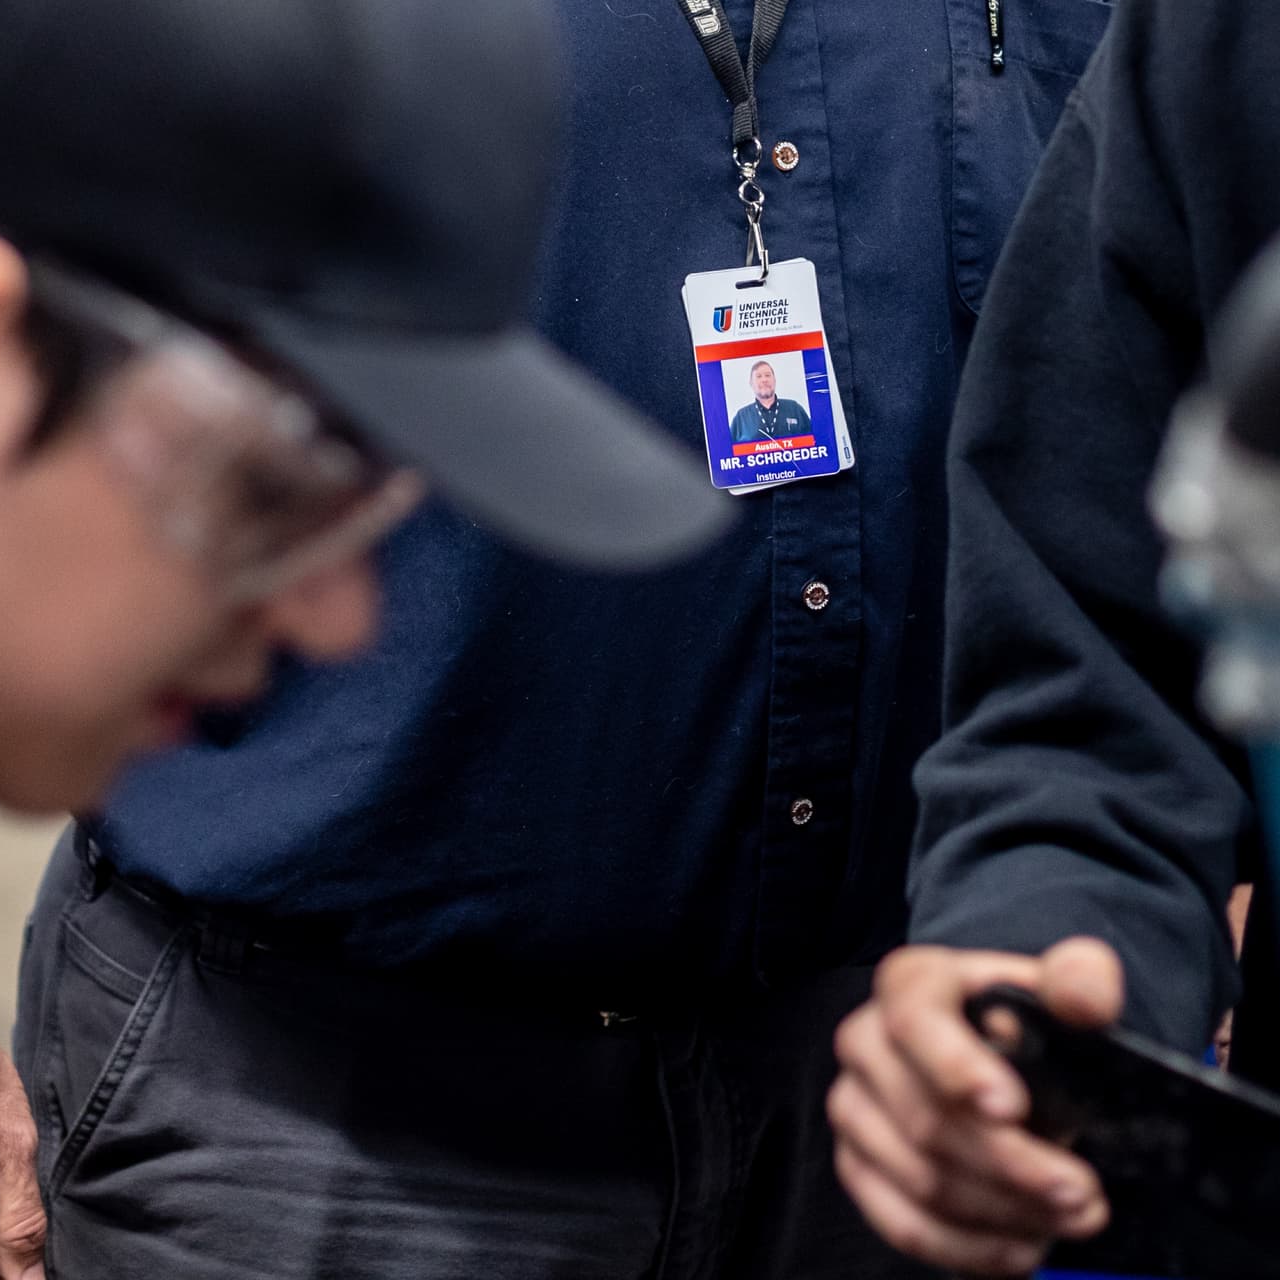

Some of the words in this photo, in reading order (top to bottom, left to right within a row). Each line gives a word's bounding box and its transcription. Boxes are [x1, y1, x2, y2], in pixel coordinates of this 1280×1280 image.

[991, 13, 999, 37] PILOT
[739, 298, 789, 311] UNIVERSAL
[739, 307, 789, 321] TECHNICAL
[739, 315, 788, 329] INSTITUTE
[782, 439, 793, 449] TX
[720, 456, 745, 471] MR.
[747, 446, 828, 466] SCHROEDER
[756, 470, 796, 482] Instructor
